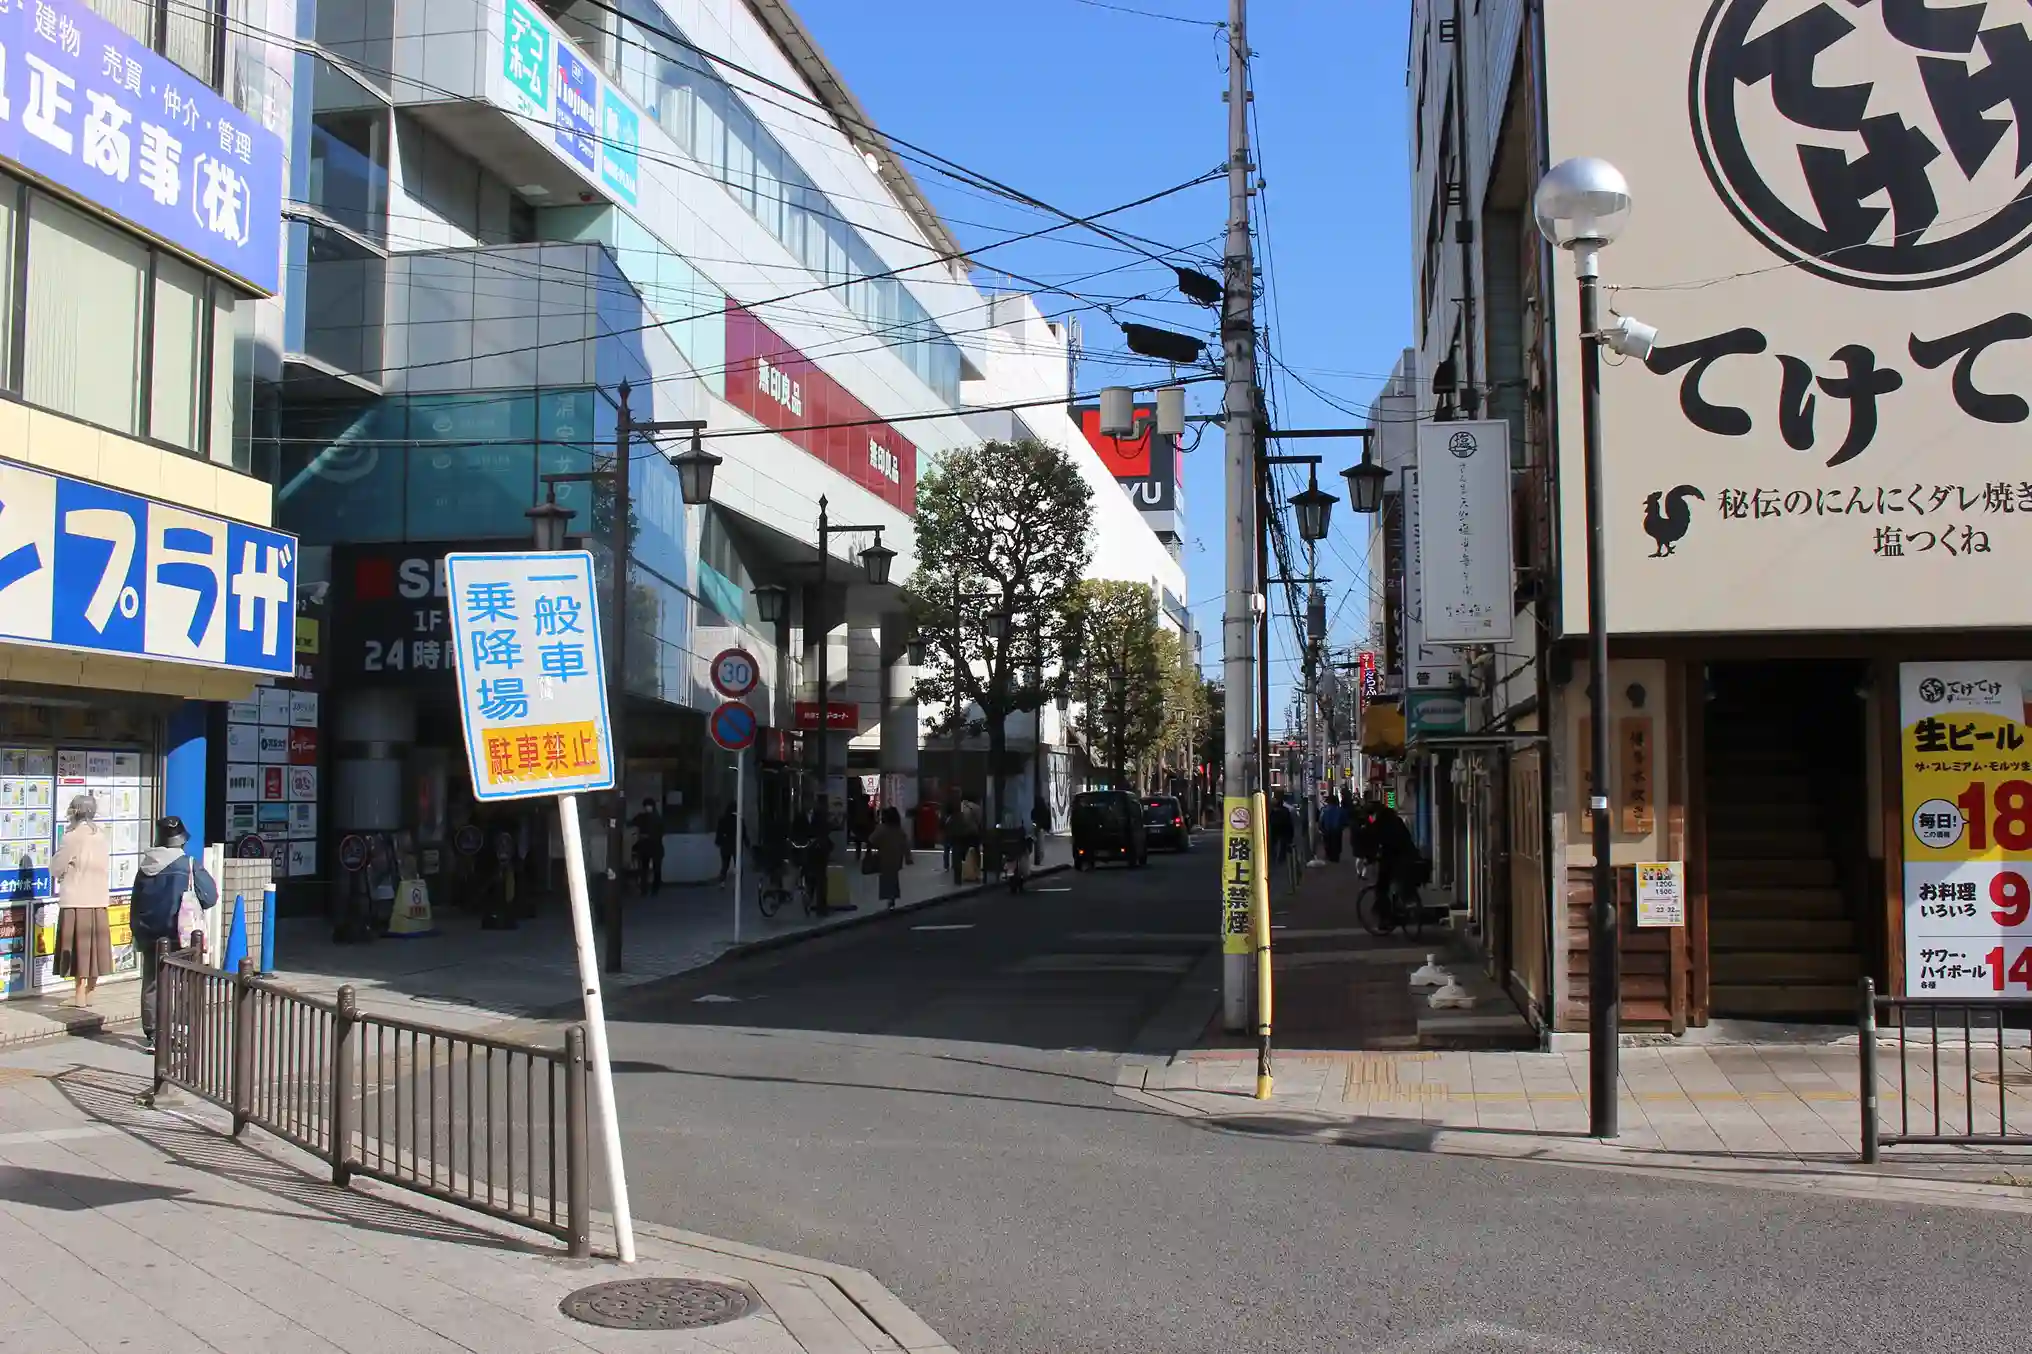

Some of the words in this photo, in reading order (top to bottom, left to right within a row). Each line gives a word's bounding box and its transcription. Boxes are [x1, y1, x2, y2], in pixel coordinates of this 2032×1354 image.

[102, 44, 252, 164] 売買・仲介・管理
[1873, 524, 1992, 557] 塩つくね
[413, 611, 442, 631] 1F
[527, 575, 588, 684] 一般車
[466, 582, 530, 721] 乗降場
[722, 661, 750, 684] 30
[1947, 679, 2002, 697] てけてけ
[1914, 717, 2024, 752] 生ビール
[487, 729, 596, 776] 駐車禁止
[1919, 812, 1957, 829] 毎日!
[1227, 836, 1251, 934] 路上禁煙
[1919, 882, 1977, 901] お料理
[1921, 903, 1977, 918] いろいろ
[1920, 964, 1987, 980] ハイボール
